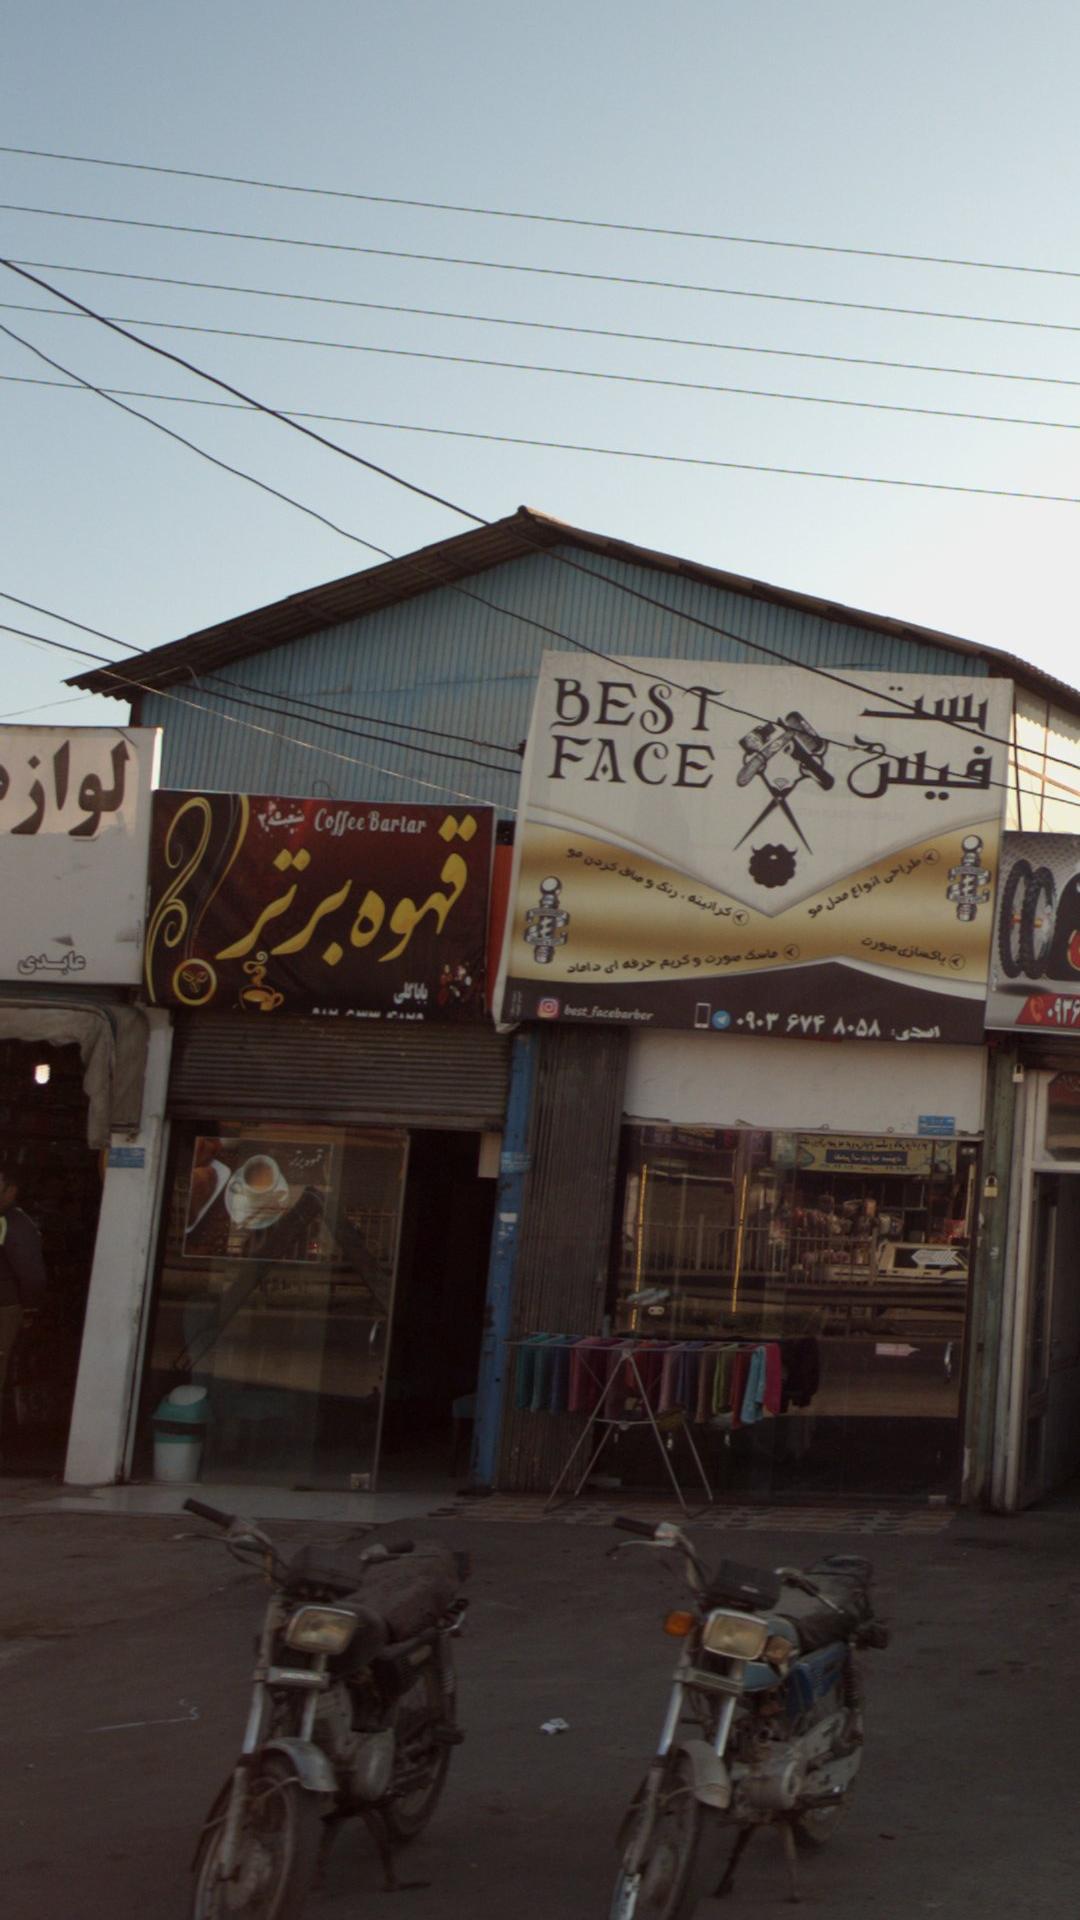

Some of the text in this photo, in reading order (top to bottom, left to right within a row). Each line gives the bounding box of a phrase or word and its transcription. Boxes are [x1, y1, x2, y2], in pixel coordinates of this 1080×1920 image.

[550, 678, 728, 735] BEST
[860, 685, 989, 732] بست
[547, 734, 715, 789] FACE
[314, 807, 427, 837] Coffee Bartar
[566, 848, 583, 859] مو
[583, 856, 618, 872] کردن
[215, 814, 477, 966] قهوه برتر
[644, 879, 654, 889] و
[656, 882, 679, 899] رنگ
[808, 857, 922, 918] طراحی انواع مدل مو
[861, 937, 897, 952] صورت
[17, 949, 87, 976] عابدی
[567, 947, 779, 975] ماسک صورت و کریم حرفه ای داماد
[736, 1010, 780, 1031] ۰۹۰۳
[786, 1013, 826, 1033] ۶۷۴
[833, 1017, 881, 1037] ۸۰۵۸
